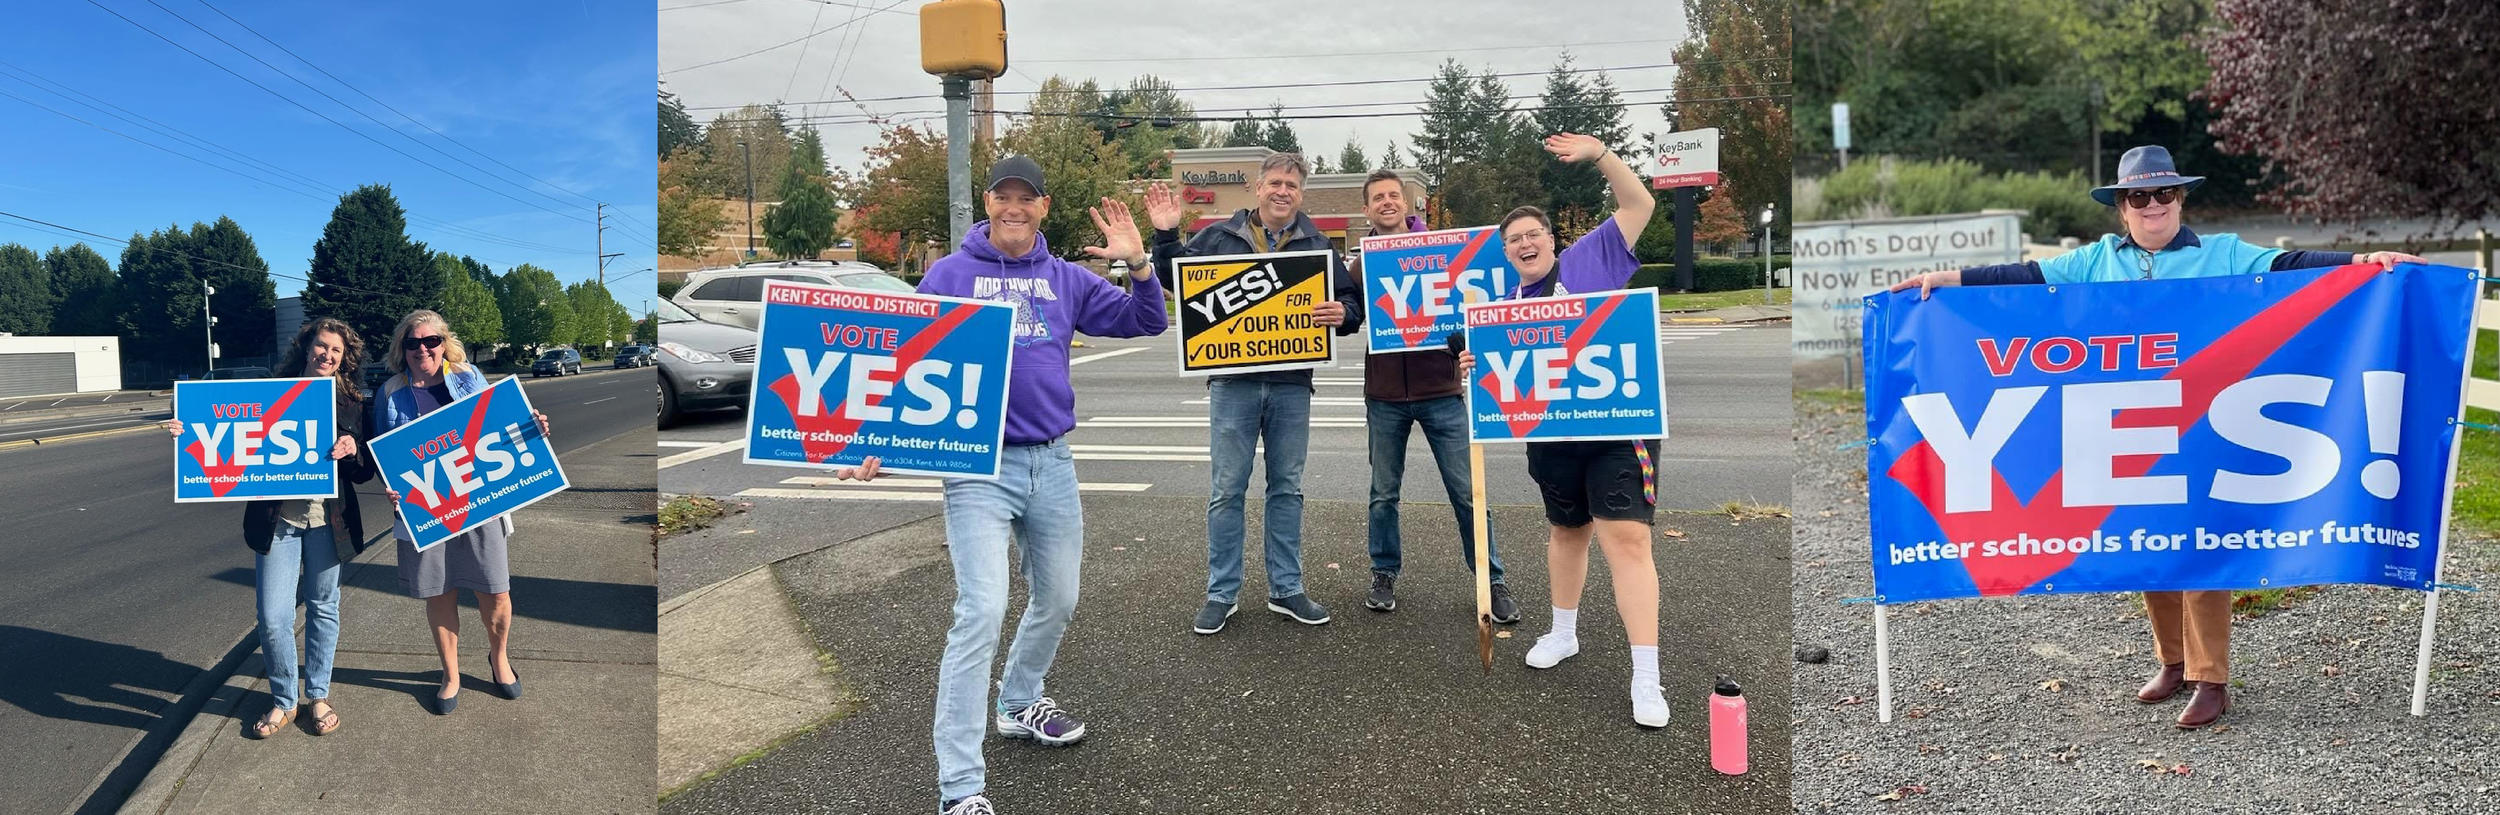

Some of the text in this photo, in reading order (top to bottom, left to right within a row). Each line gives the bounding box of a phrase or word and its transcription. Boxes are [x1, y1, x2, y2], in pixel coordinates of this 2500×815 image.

[1659, 140, 1702, 154] KeyBank
[1182, 169, 1246, 186] KeyBank
[1365, 233, 1468, 251] KENT SCHOOL DISTRICT
[1792, 227, 1995, 258] Mom's Day Out
[1187, 268, 1218, 282] VOTE
[1398, 254, 1448, 272] VOTE
[770, 288, 938, 316] KENT SCHOOL DISTRICT
[1188, 262, 1284, 324] YES!
[1286, 293, 1312, 307] FOR
[1379, 267, 1506, 319] YES!
[1244, 315, 1279, 332] OUR
[1470, 302, 1583, 325] KENT SCHOOLS
[820, 322, 899, 351] VOTE
[1376, 328, 1404, 336] better
[1406, 324, 1439, 334] schools
[1441, 323, 1454, 331] for
[1506, 326, 1566, 346] VOTE
[1206, 336, 1324, 360] OUR SCHOOLS
[1976, 333, 2179, 377] VOTE
[1484, 342, 1640, 402] YES!
[782, 347, 983, 430] YES!
[212, 403, 263, 418] VOTE
[1478, 408, 1655, 422] better schools for better futures
[191, 420, 319, 467] YES!
[411, 429, 462, 461] VOTE
[761, 425, 989, 454] better schools for better futures
[1901, 370, 2406, 514] YES!
[775, 449, 802, 458] Citizens
[949, 461, 972, 469] 98064
[184, 471, 329, 484] better schools for better futures
[399, 422, 536, 510] YES!
[416, 468, 553, 533] better schools for better futures
[1890, 520, 2420, 565] better schools for better futures
